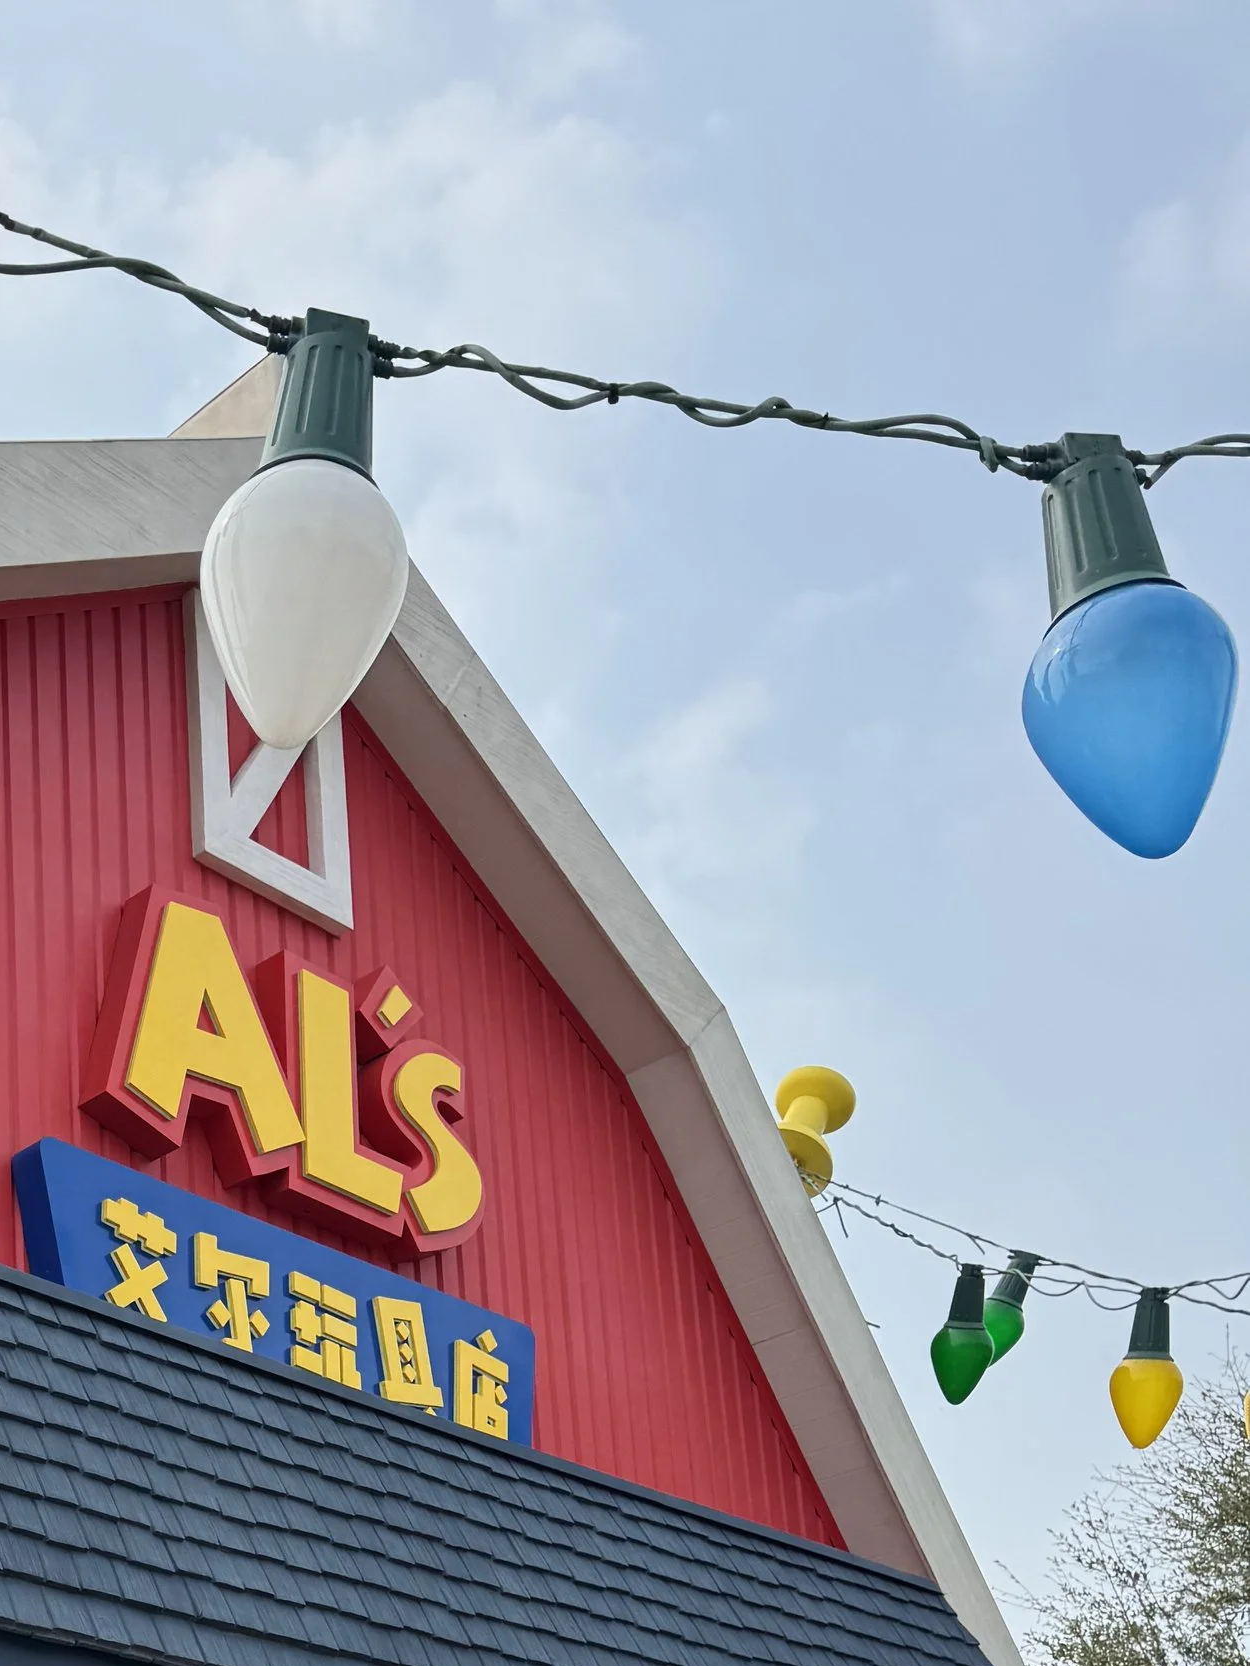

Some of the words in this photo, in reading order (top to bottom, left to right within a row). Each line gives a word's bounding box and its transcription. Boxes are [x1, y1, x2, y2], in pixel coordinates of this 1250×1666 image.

[101, 1197, 510, 1442] 艾尔玩具店
